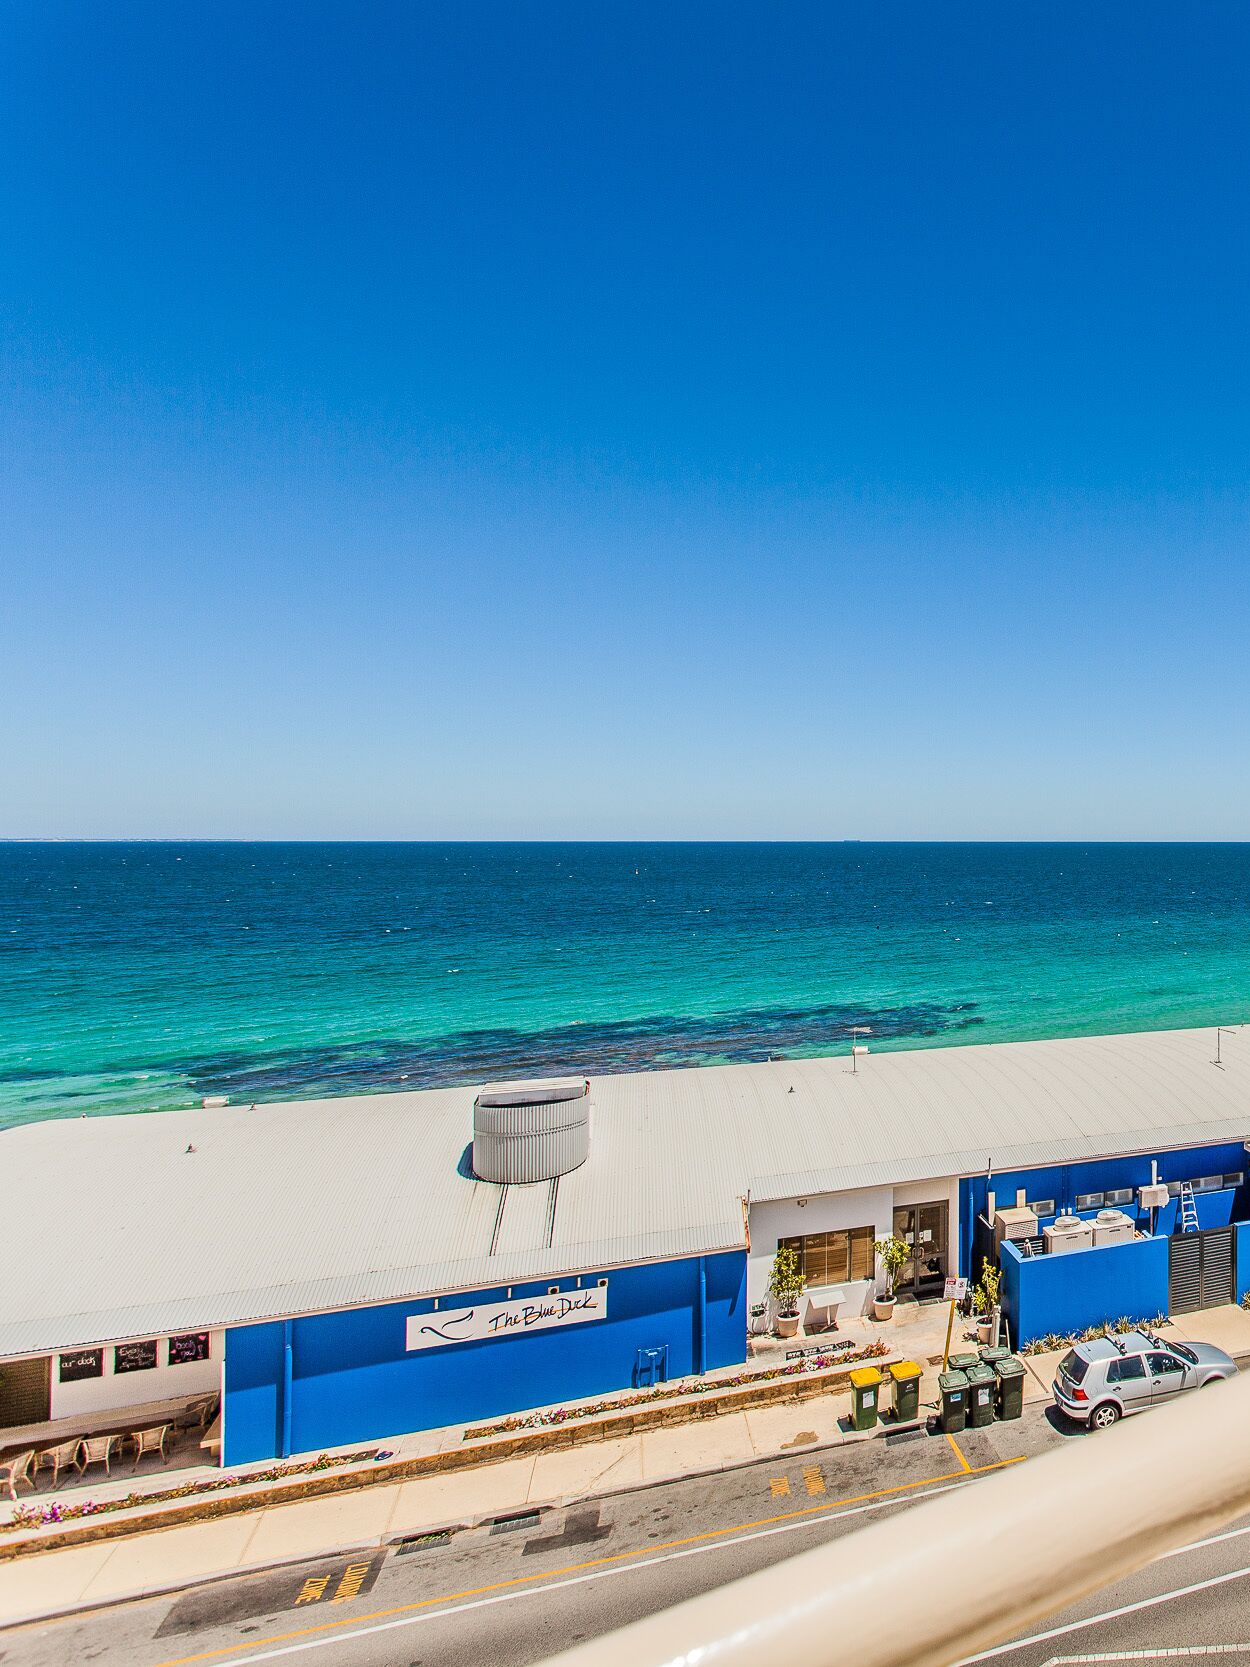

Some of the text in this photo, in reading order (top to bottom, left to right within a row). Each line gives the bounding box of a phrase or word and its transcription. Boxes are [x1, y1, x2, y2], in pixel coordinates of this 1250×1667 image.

[488, 1291, 598, 1332] The Blue Duck
[294, 1574, 331, 1604] ZONE
[331, 1561, 371, 1604] LOADING
